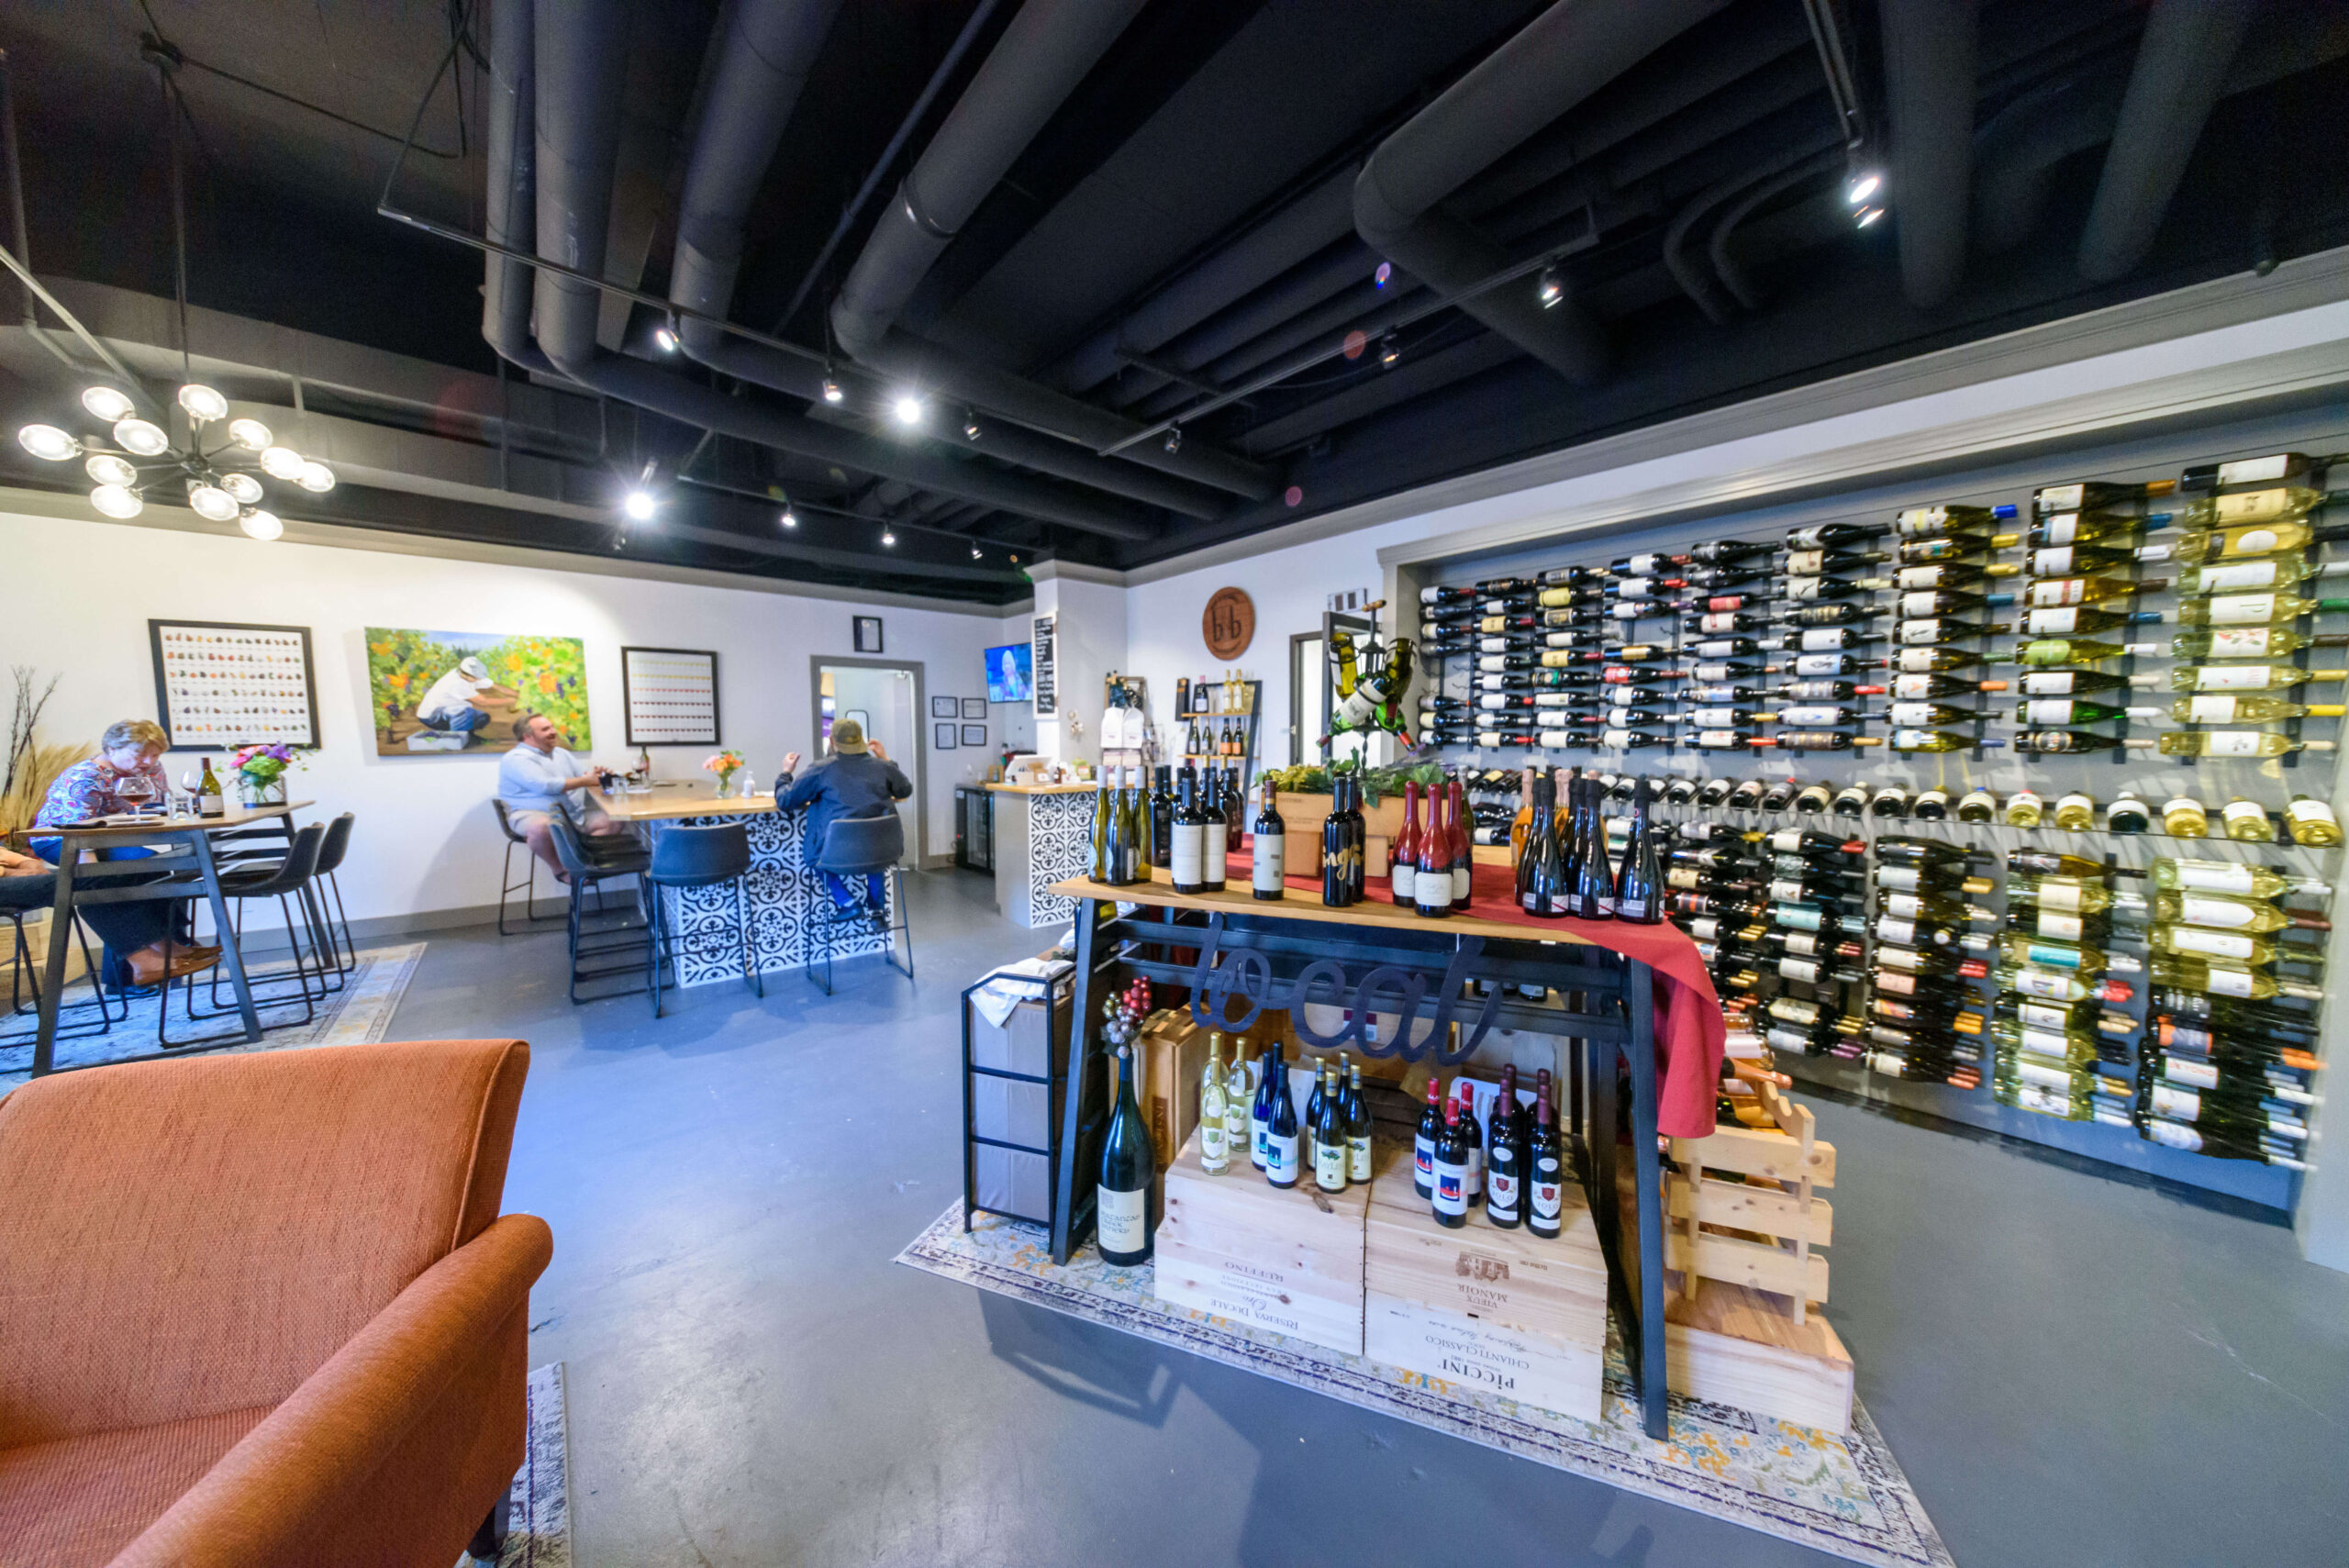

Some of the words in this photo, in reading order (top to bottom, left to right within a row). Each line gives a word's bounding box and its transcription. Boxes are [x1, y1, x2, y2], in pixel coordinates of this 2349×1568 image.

[1190, 911, 1503, 1067] local
[1225, 1262, 1284, 1282] RUFFINO
[1458, 1284, 1508, 1303] MANOIR
[1466, 1295, 1498, 1308] VIEUX
[1211, 1298, 1249, 1317] DUCALE
[1254, 1310, 1298, 1330] RISERVA
[1425, 1335, 1478, 1355] CLASSICO
[1480, 1350, 1531, 1370] CHIANTI
